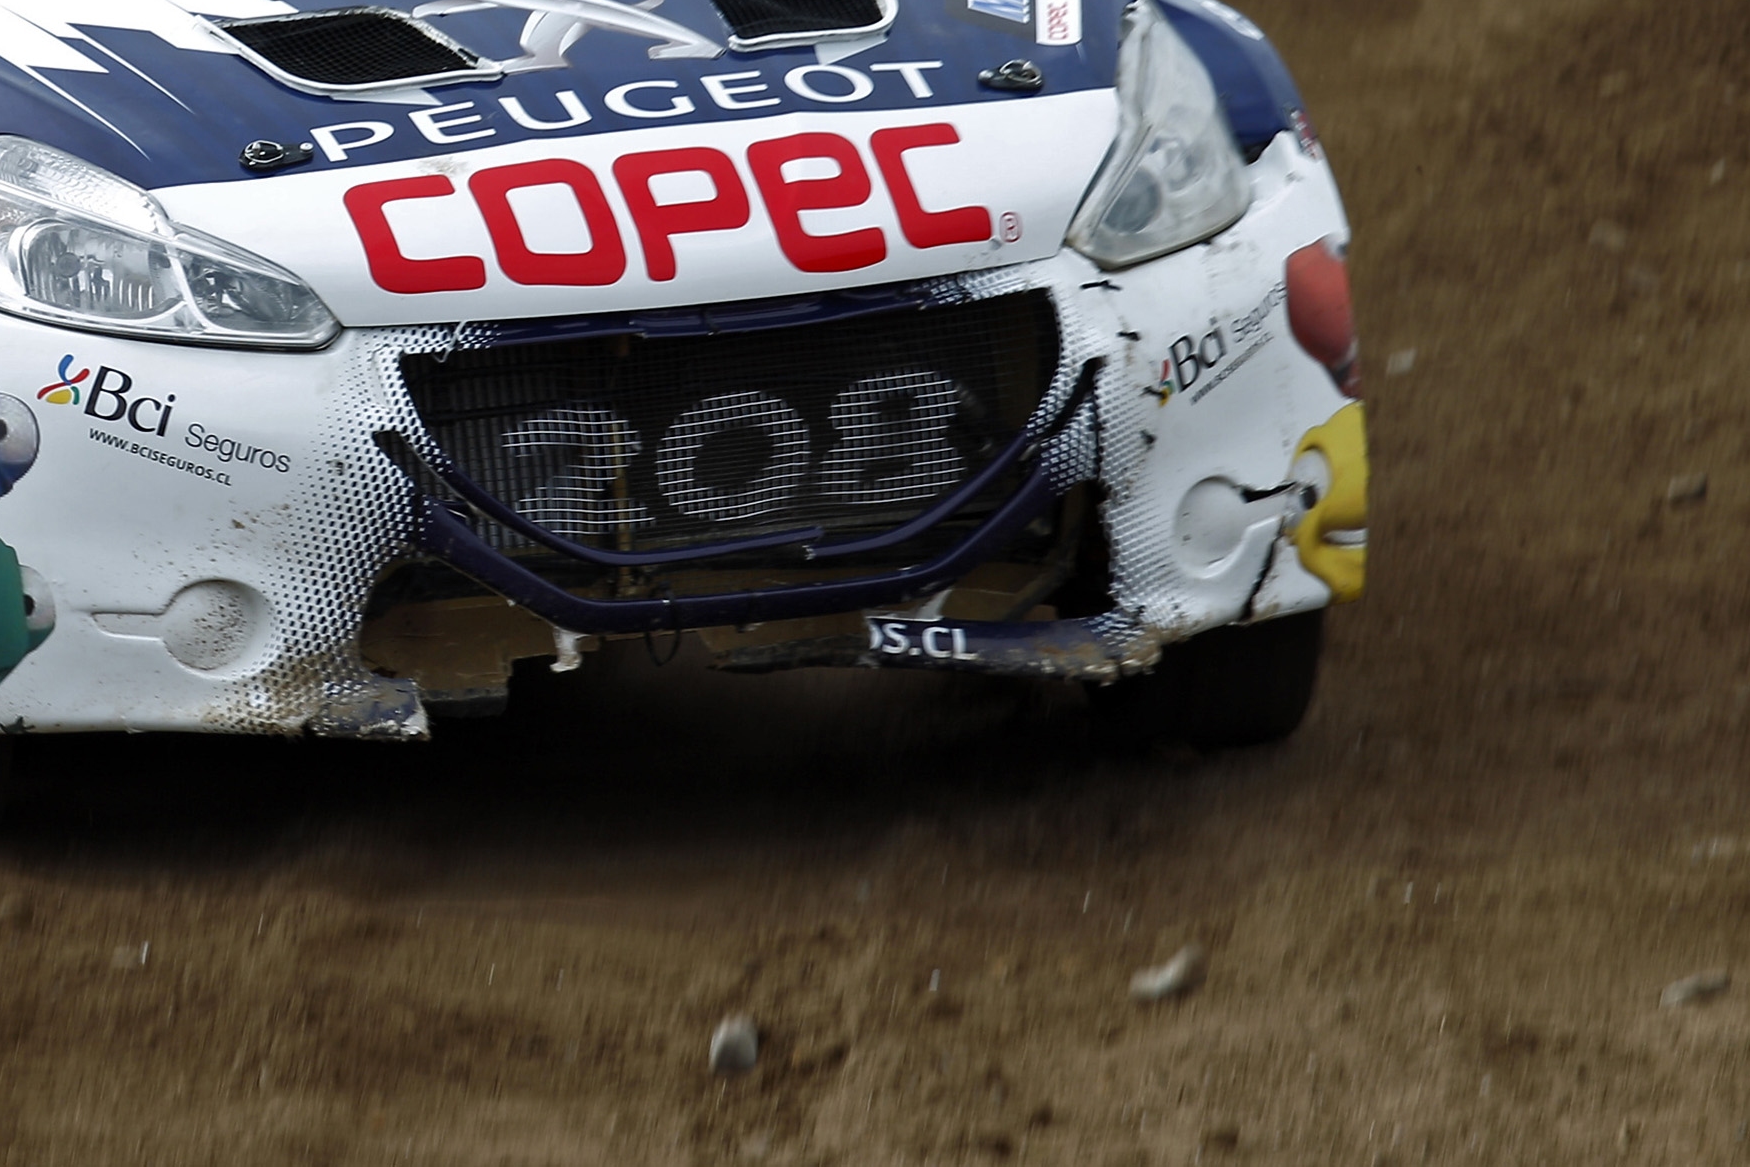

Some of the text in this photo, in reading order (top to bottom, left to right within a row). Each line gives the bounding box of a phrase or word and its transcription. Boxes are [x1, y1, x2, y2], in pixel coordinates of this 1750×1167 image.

[310, 59, 945, 163] PEUGEOT
[84, 365, 292, 474] Bci Seguros
[88, 428, 233, 487] WWW.BCISEGUROS.CL
[501, 370, 967, 534] 208
